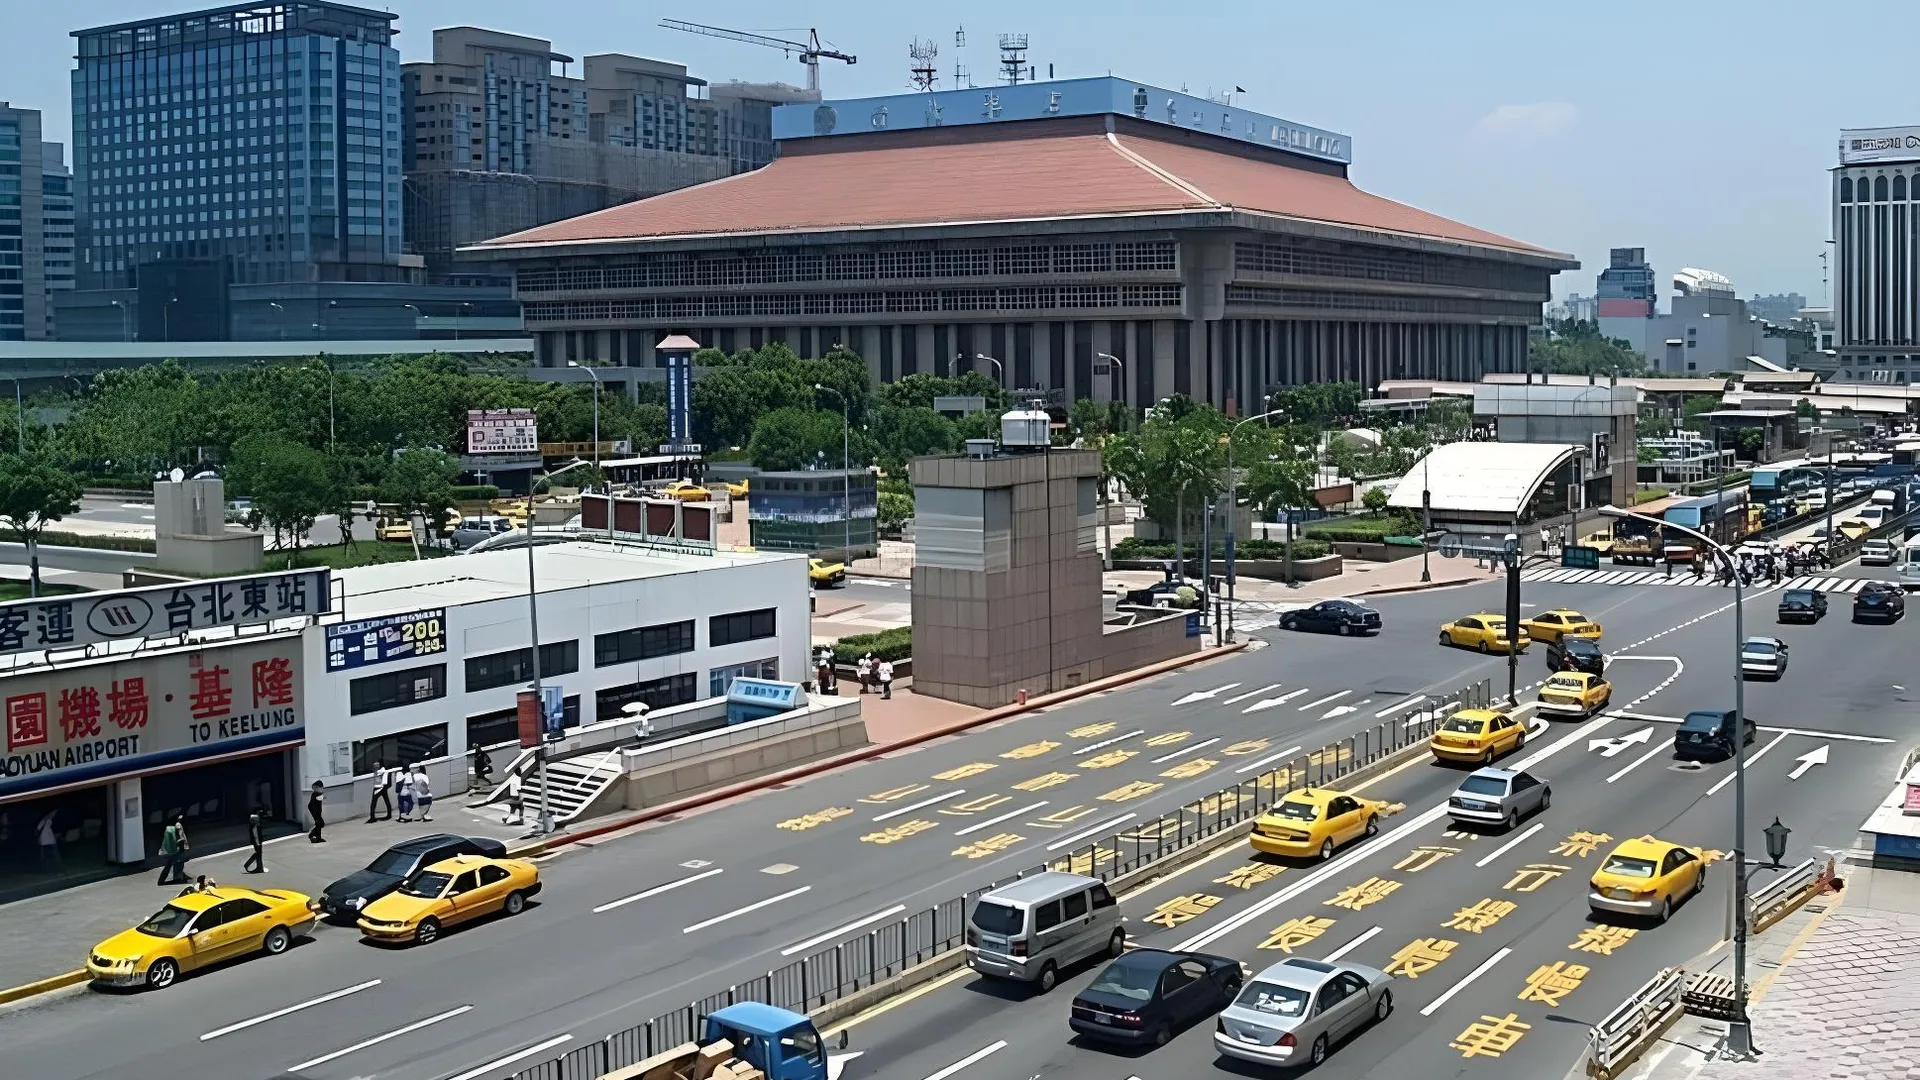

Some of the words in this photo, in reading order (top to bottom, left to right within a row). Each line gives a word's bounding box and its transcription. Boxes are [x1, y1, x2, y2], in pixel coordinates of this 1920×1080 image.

[0, 602, 74, 651] 客運
[164, 575, 305, 631] 台北東站
[189, 722, 211, 742] TO
[219, 707, 295, 739] KEELUNG
[65, 734, 139, 767] AIRPORT
